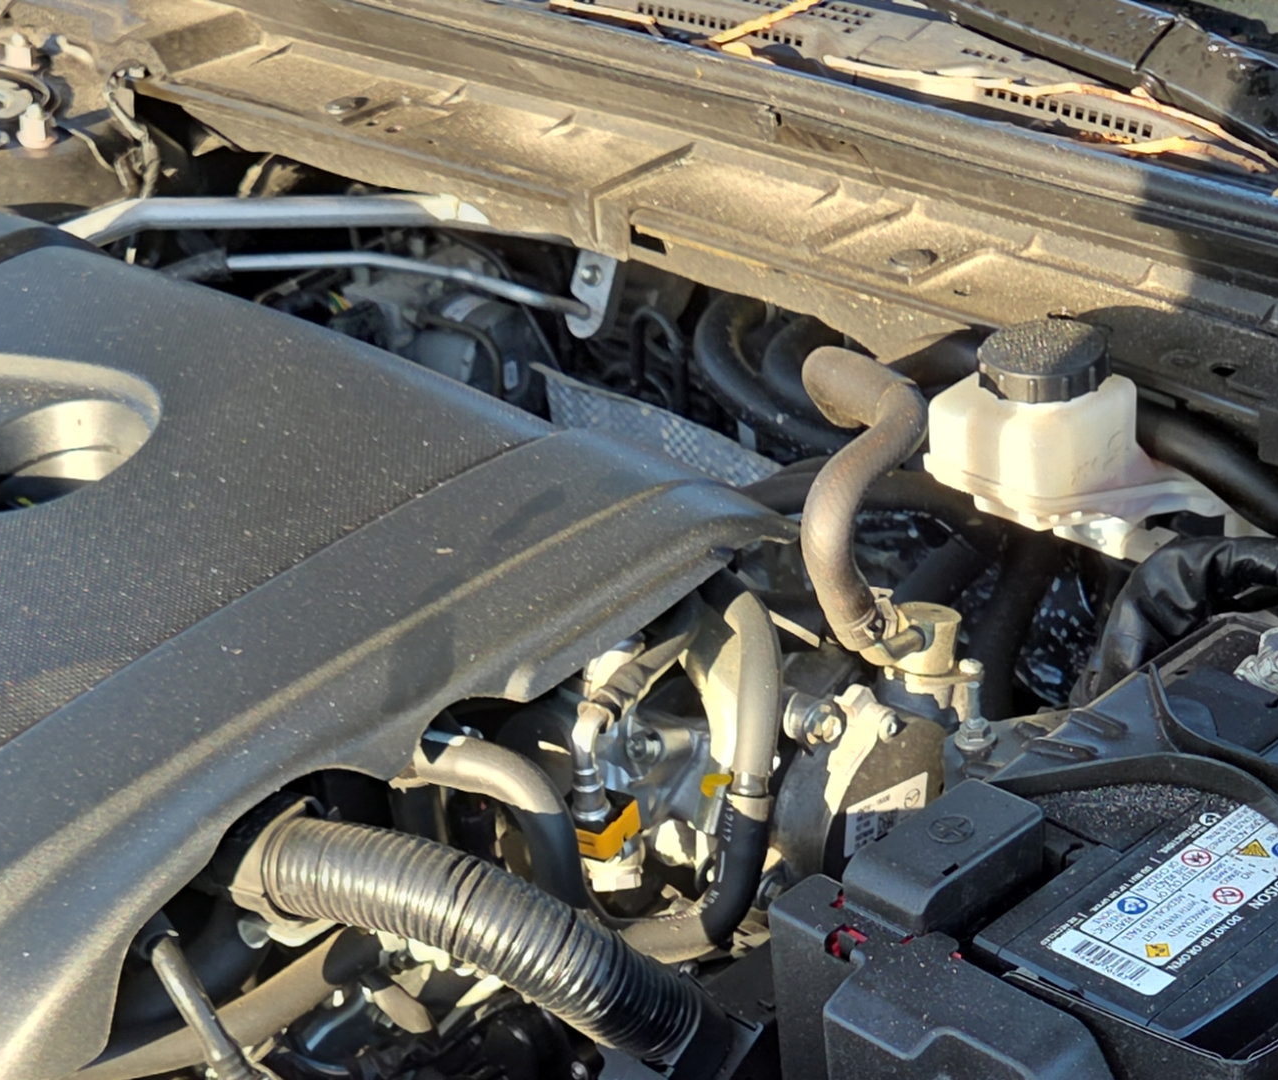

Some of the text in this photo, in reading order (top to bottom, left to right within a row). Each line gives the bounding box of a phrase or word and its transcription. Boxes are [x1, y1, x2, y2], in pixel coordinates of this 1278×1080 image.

[1226, 915, 1243, 926] DO
[1142, 930, 1157, 942] GET
[1210, 924, 1230, 938] NOT
[1200, 937, 1215, 947] TIP
[1186, 945, 1202, 955] OR
